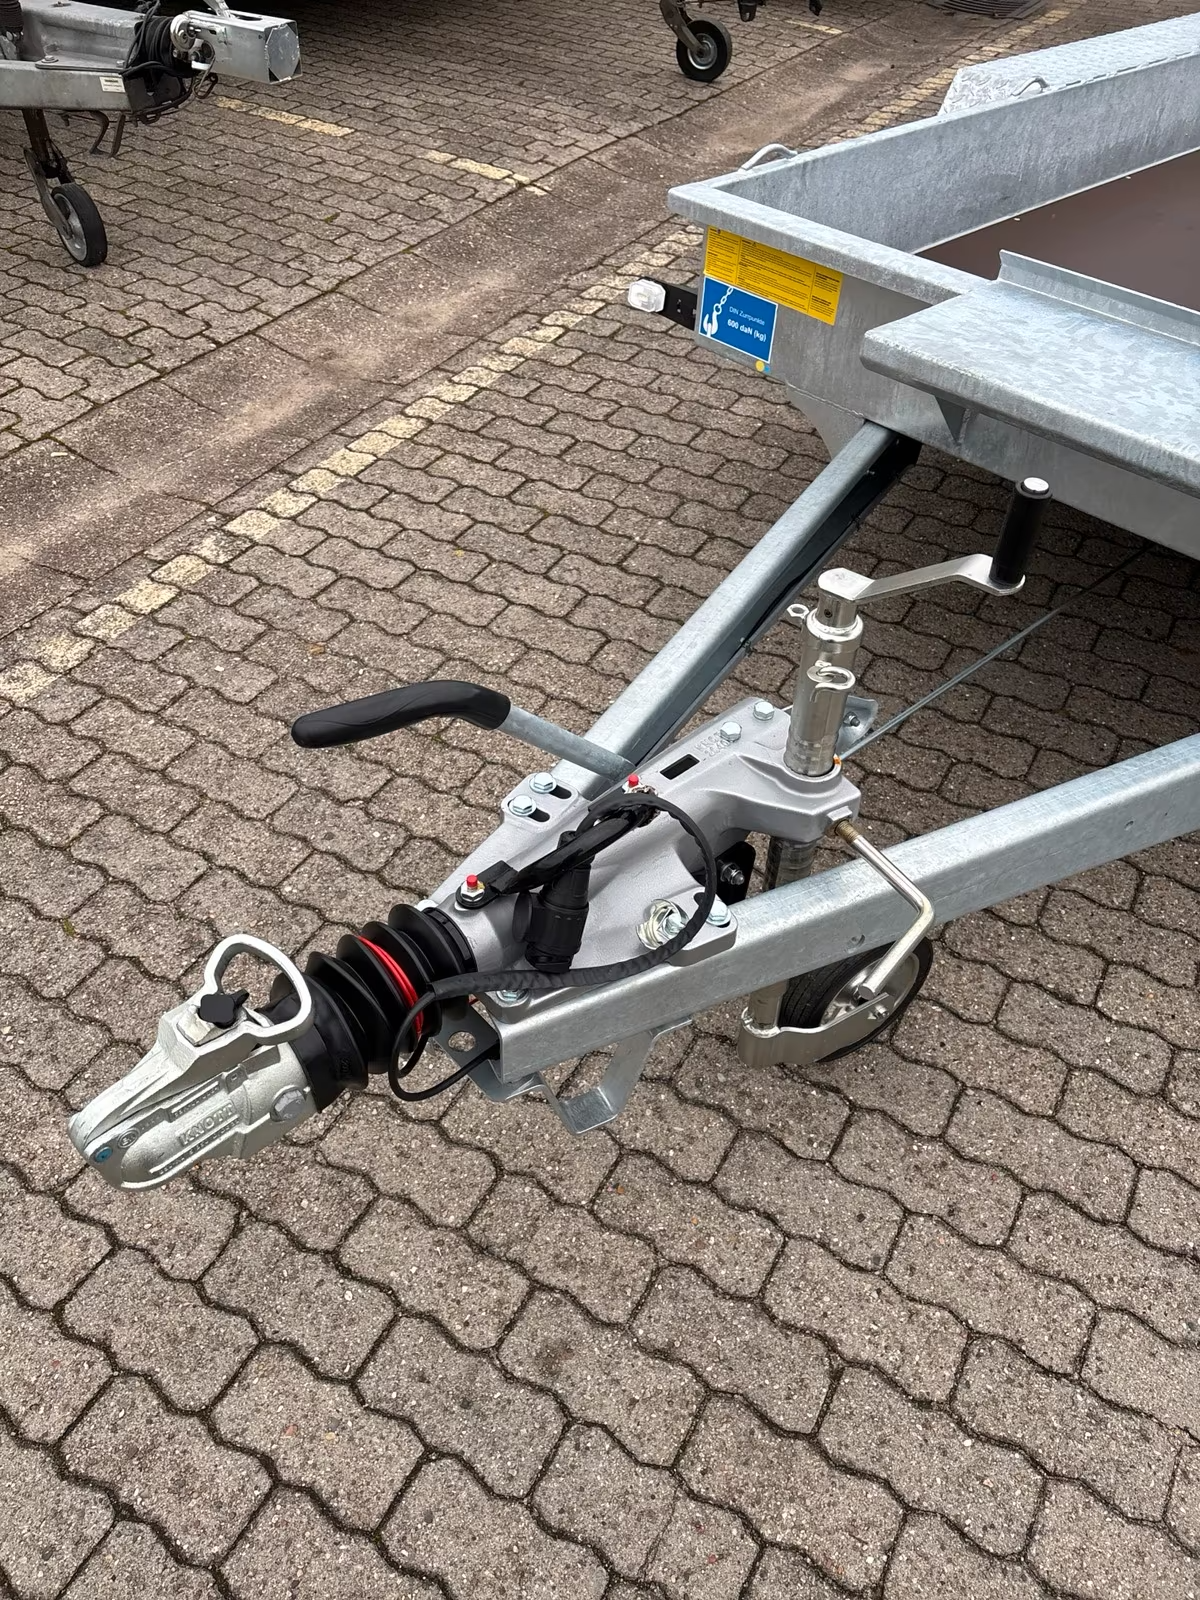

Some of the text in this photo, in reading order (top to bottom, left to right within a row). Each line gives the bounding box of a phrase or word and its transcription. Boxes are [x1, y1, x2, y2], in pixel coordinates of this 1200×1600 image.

[729, 306, 739, 315] DIN
[727, 318, 767, 343] 600 daN (kg)
[180, 1102, 236, 1148] KNOTT
